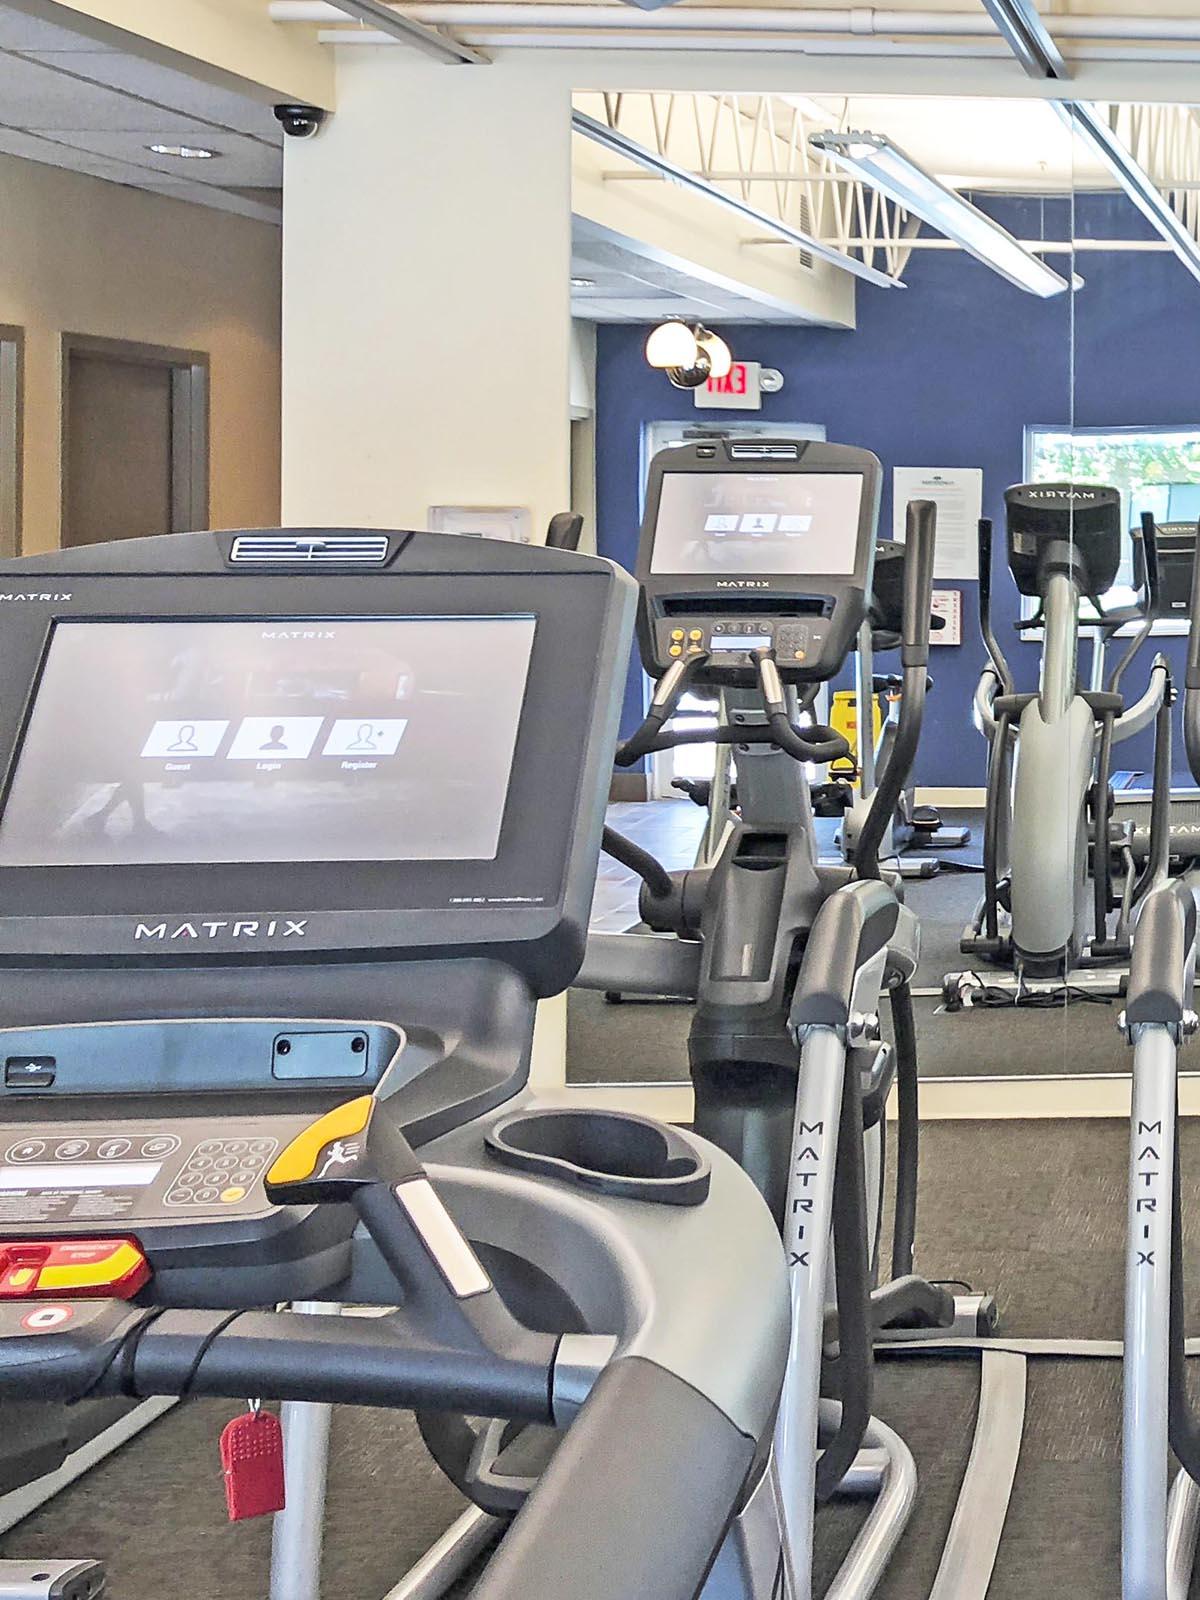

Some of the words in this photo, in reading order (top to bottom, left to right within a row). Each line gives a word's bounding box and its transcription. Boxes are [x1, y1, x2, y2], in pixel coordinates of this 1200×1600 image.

[716, 580, 770, 588] MATRIX
[0, 593, 73, 601] MATRIX
[261, 631, 337, 640] MATRIX
[133, 920, 308, 940] MATRIX
[789, 1121, 824, 1267] MATRIX
[1136, 1120, 1162, 1266] MATRIX
